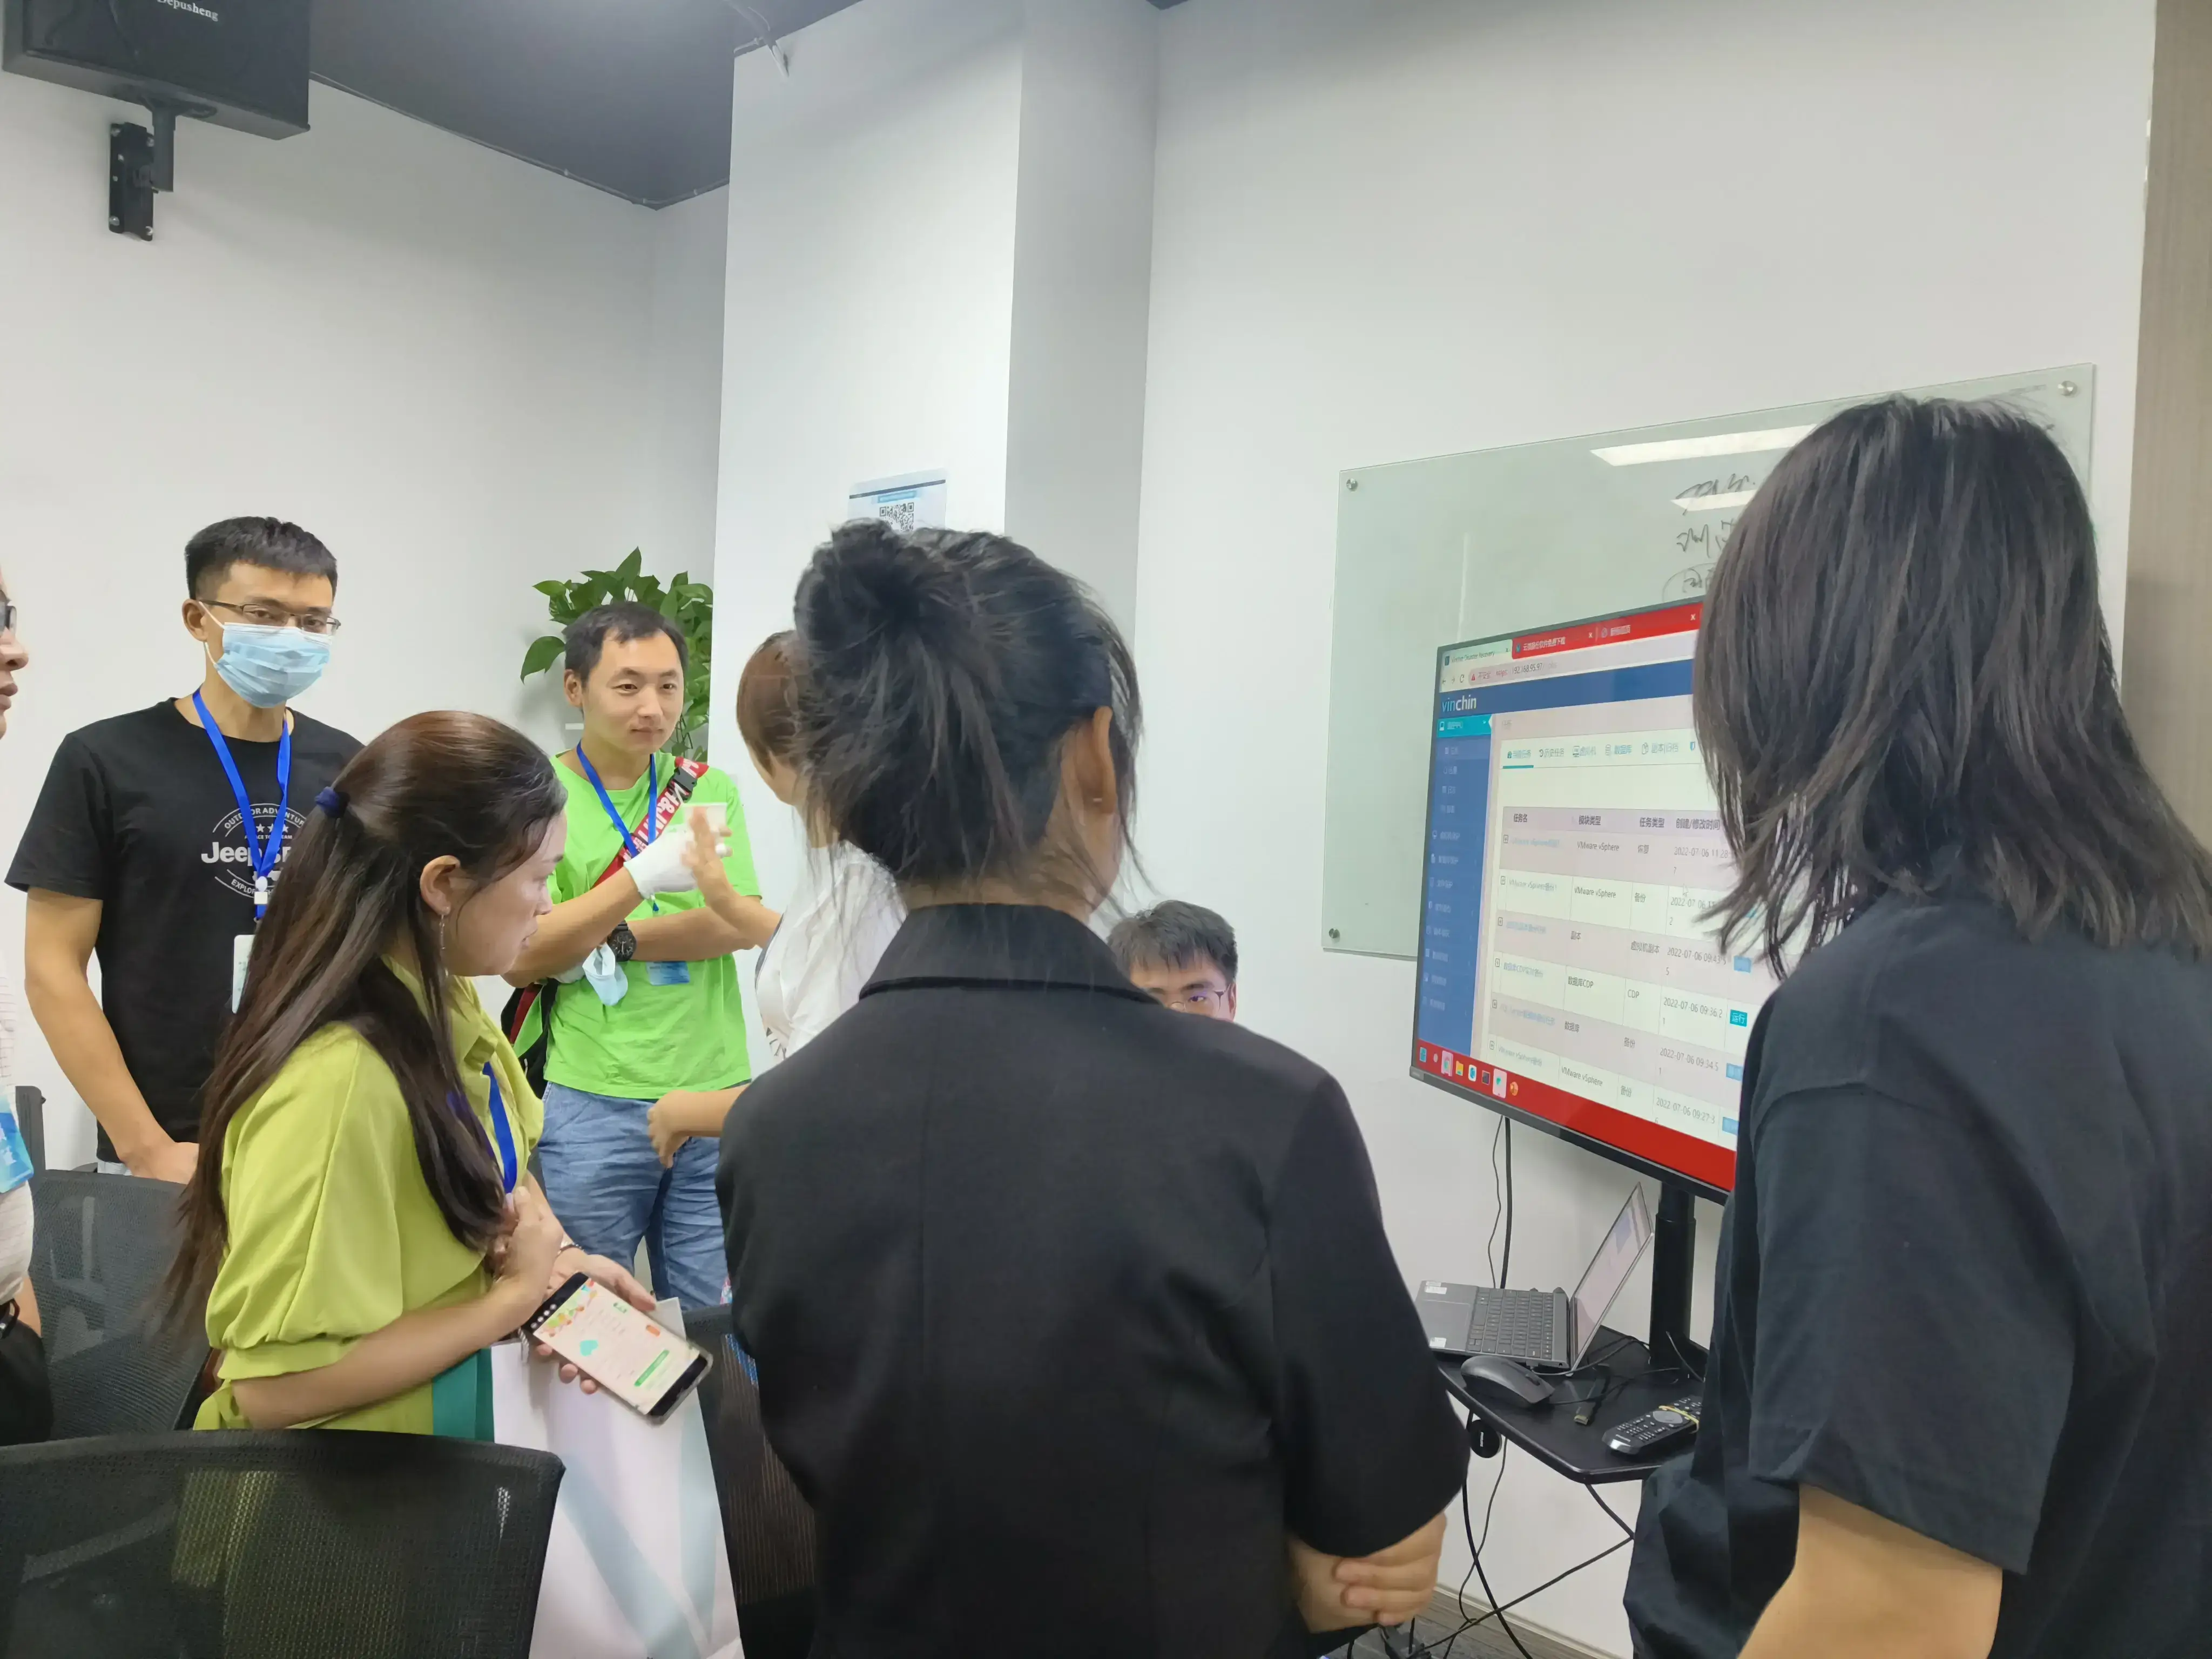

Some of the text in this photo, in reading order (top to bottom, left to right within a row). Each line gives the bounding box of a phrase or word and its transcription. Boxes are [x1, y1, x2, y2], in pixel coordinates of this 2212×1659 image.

[1442, 694, 1476, 712] vinchin
[1514, 813, 1527, 822] 任务名
[1579, 815, 1601, 825] 模块类型
[1640, 817, 1664, 828] 任务类型
[1676, 818, 1720, 830] 创建/修改时间
[1577, 841, 1619, 852] VMware vSphere
[1638, 845, 1649, 854] 恢复
[1574, 887, 1616, 898] VMware vSphere
[1634, 893, 1646, 903] 备份
[1631, 941, 1660, 954] 虚拟机副本
[1667, 947, 1702, 961] 2022-07-06
[1666, 967, 1670, 975] 5
[1627, 989, 1640, 999] CDP
[1663, 997, 1698, 1013] 2022-07-06
[1624, 1037, 1635, 1048] 备份
[1660, 1048, 1694, 1064] 2022-07-06
[1562, 1066, 1603, 1087] VMware vSphere
[1621, 1085, 1632, 1097] 备份
